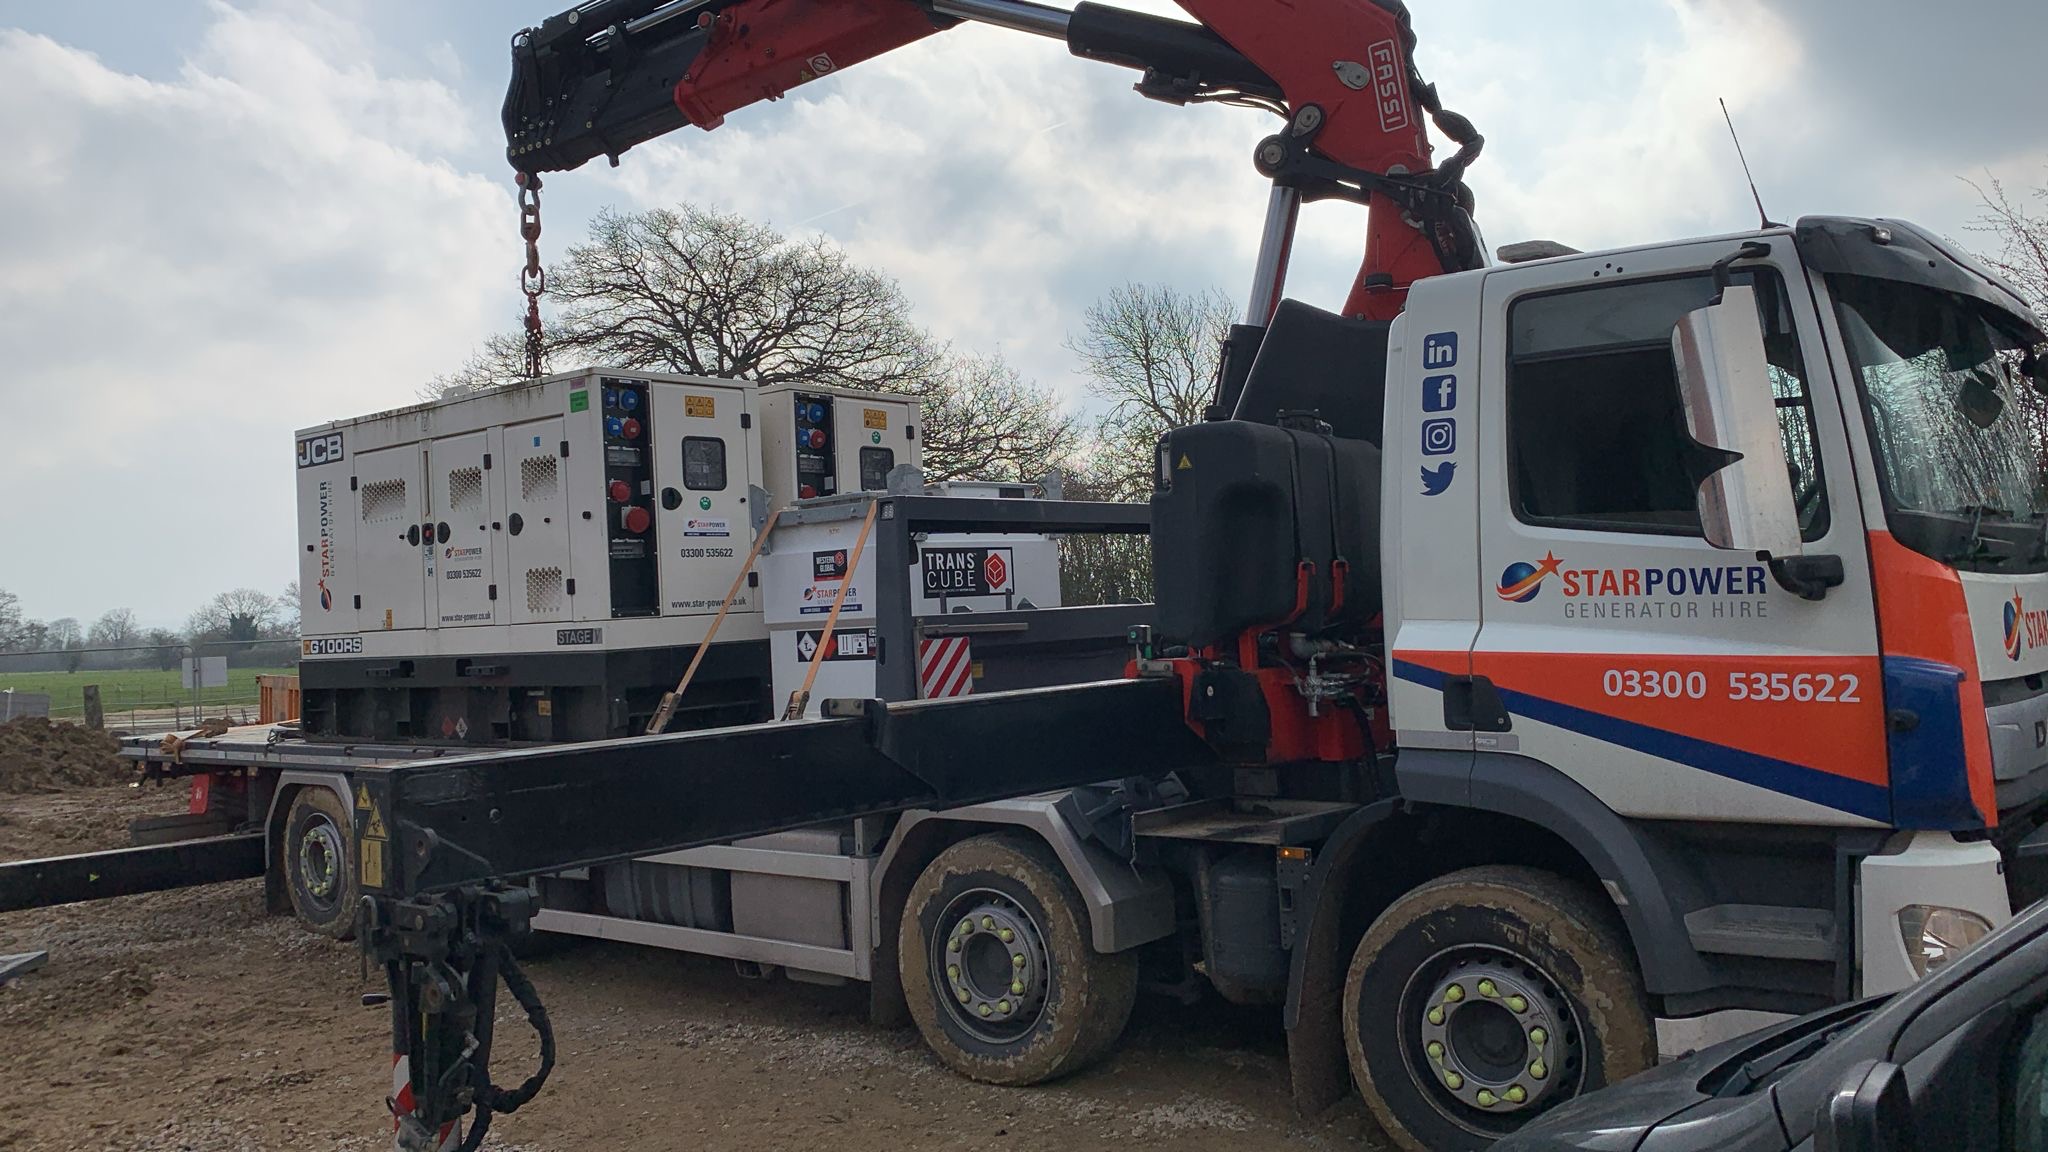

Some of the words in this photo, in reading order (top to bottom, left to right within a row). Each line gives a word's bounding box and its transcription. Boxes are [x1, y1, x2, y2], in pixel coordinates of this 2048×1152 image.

[1374, 49, 1402, 123] FASSI
[298, 435, 343, 466] JCB
[319, 481, 330, 578] STARPOWER
[680, 548, 704, 558] 03300
[705, 548, 733, 558] 535622
[925, 552, 975, 570] TRANS
[819, 563, 836, 573] GLOBAL
[927, 570, 976, 588] CUBE
[1562, 566, 1767, 598] STARPOWER
[816, 587, 857, 599] STARPER
[1563, 601, 1699, 618] GENERATOR
[1712, 601, 1769, 619] HIRE
[310, 637, 362, 654] G100RS
[558, 630, 591, 644] STAGE
[1603, 669, 1707, 700] 03300
[1728, 672, 1861, 704] 535622
